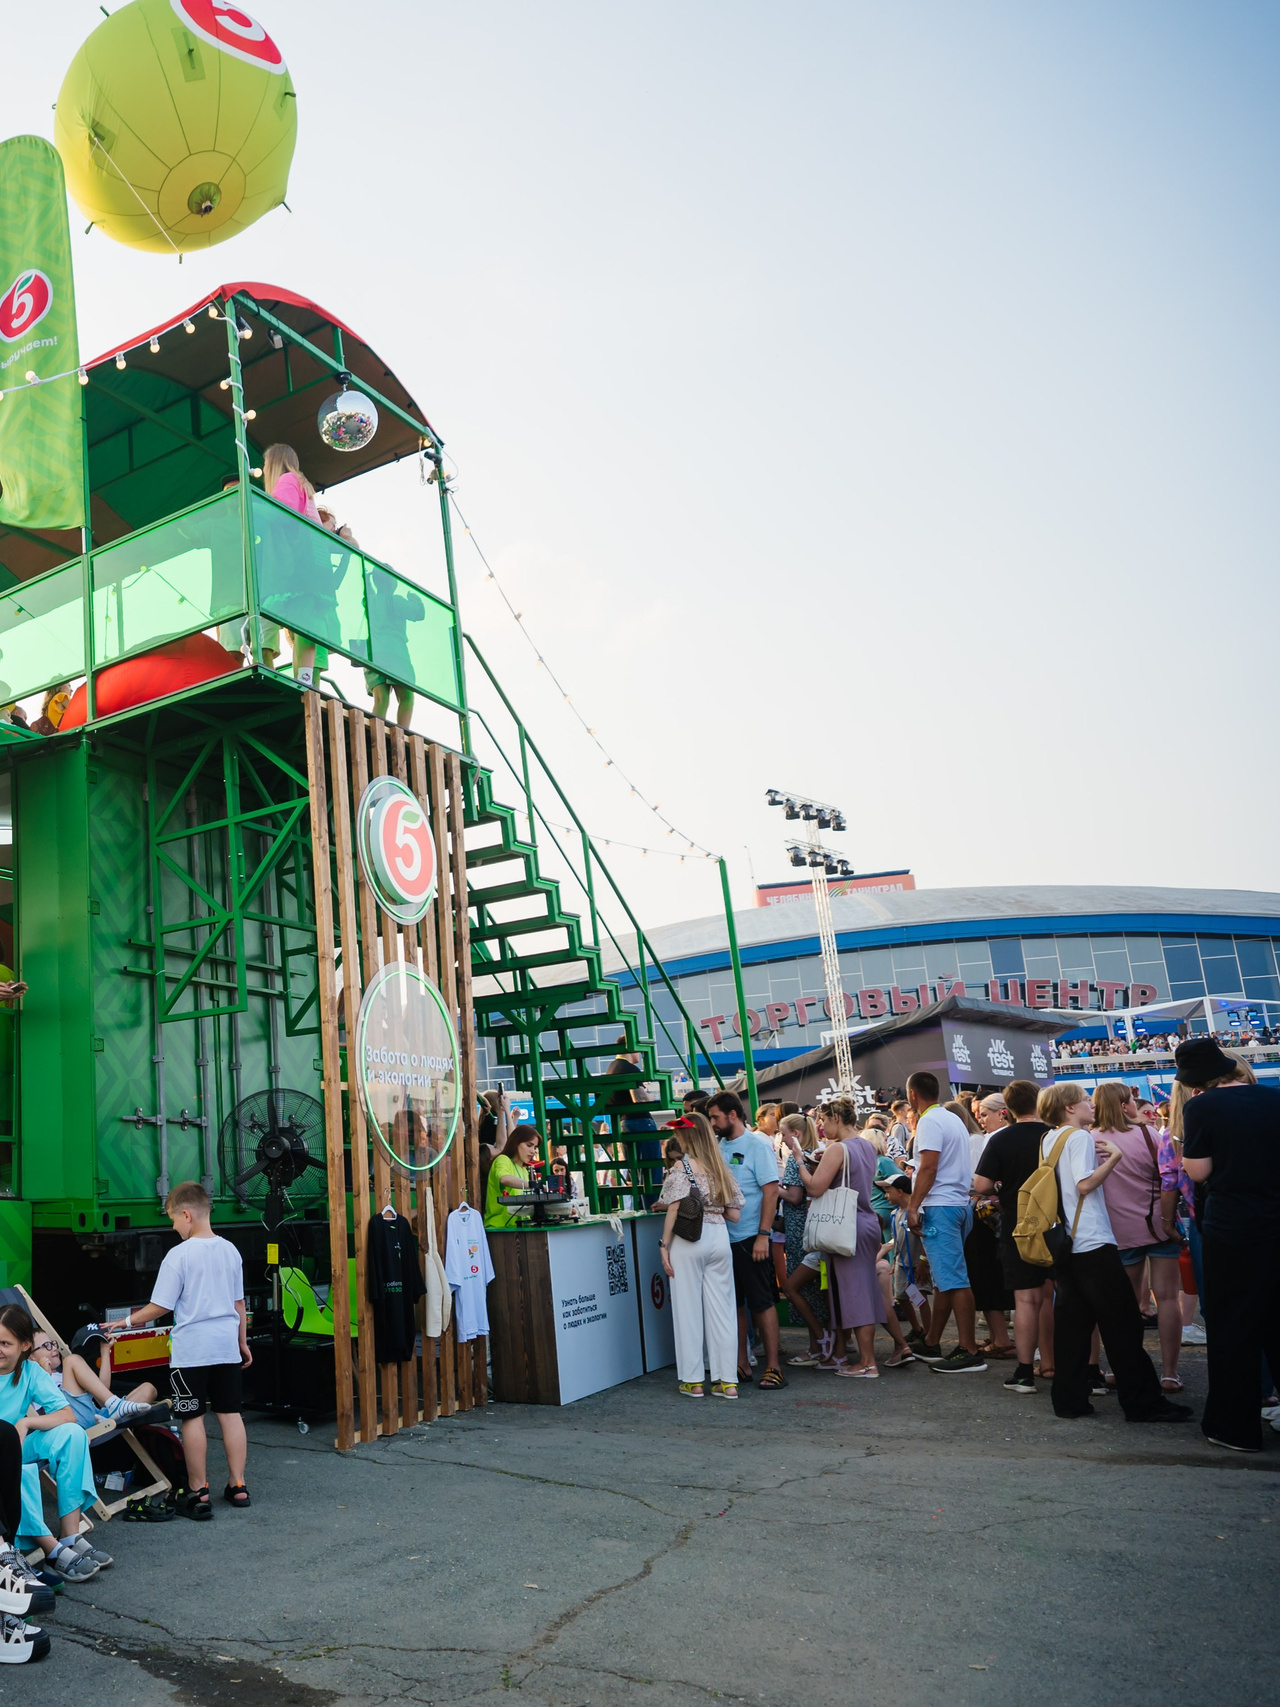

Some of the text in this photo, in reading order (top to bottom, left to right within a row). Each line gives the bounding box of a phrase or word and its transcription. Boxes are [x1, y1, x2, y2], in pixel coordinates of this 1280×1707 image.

[11, 273, 36, 329] 5
[394, 804, 423, 881] 5
[700, 971, 1159, 1044] ТОРГОВЫЙ ЦЕНТР
[952, 1043, 971, 1063] fest
[990, 1039, 1007, 1054] VK
[365, 1044, 454, 1072] Забота о людях
[987, 1047, 1015, 1069] fest
[1030, 1052, 1048, 1071] fest
[367, 1069, 432, 1088] и экологии
[809, 1213, 845, 1225] MEOW
[172, 1396, 200, 1412] das
